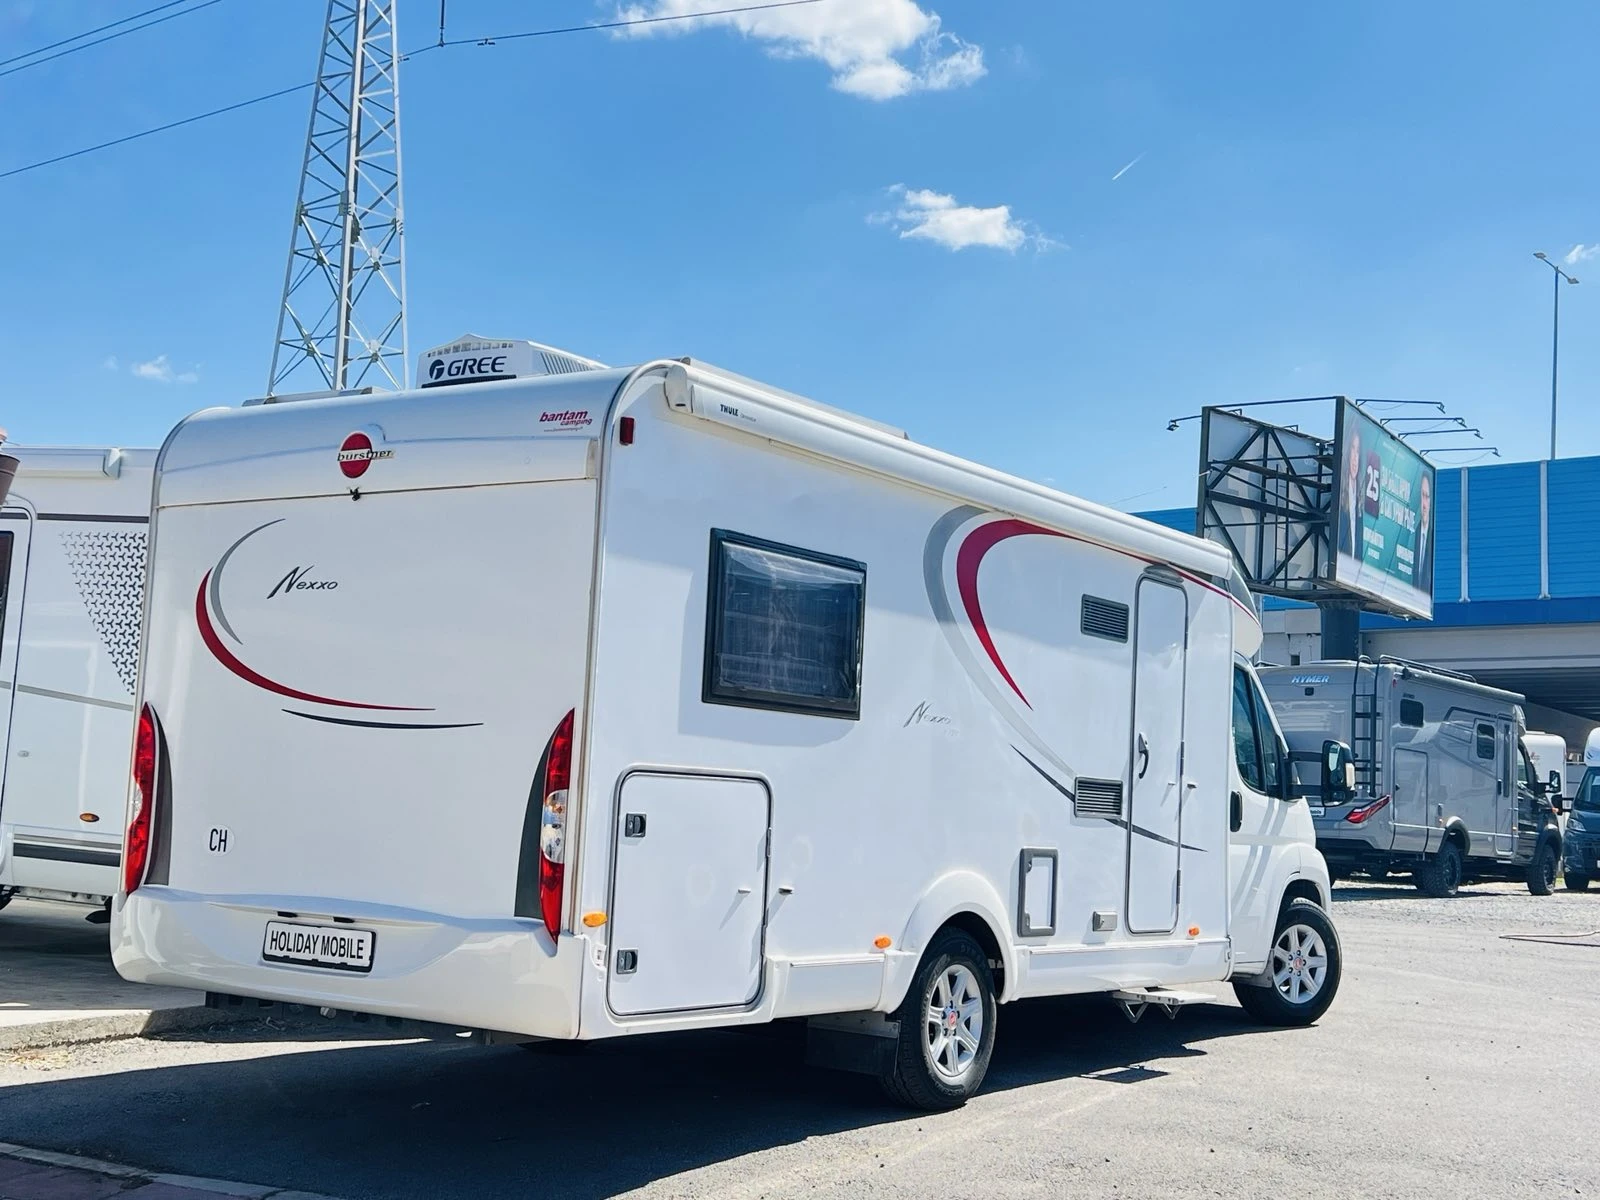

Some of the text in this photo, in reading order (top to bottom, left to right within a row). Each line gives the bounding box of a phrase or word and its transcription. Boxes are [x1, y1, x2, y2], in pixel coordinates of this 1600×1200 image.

[447, 356, 507, 377] GREE
[539, 410, 588, 422] bantam
[720, 404, 739, 417] THULE
[1366, 465, 1379, 502] 25
[266, 564, 338, 599] Nexxo
[1291, 675, 1330, 684] HYMER
[209, 828, 228, 852] CH
[269, 930, 365, 959] HOLIDAY MOBILE
